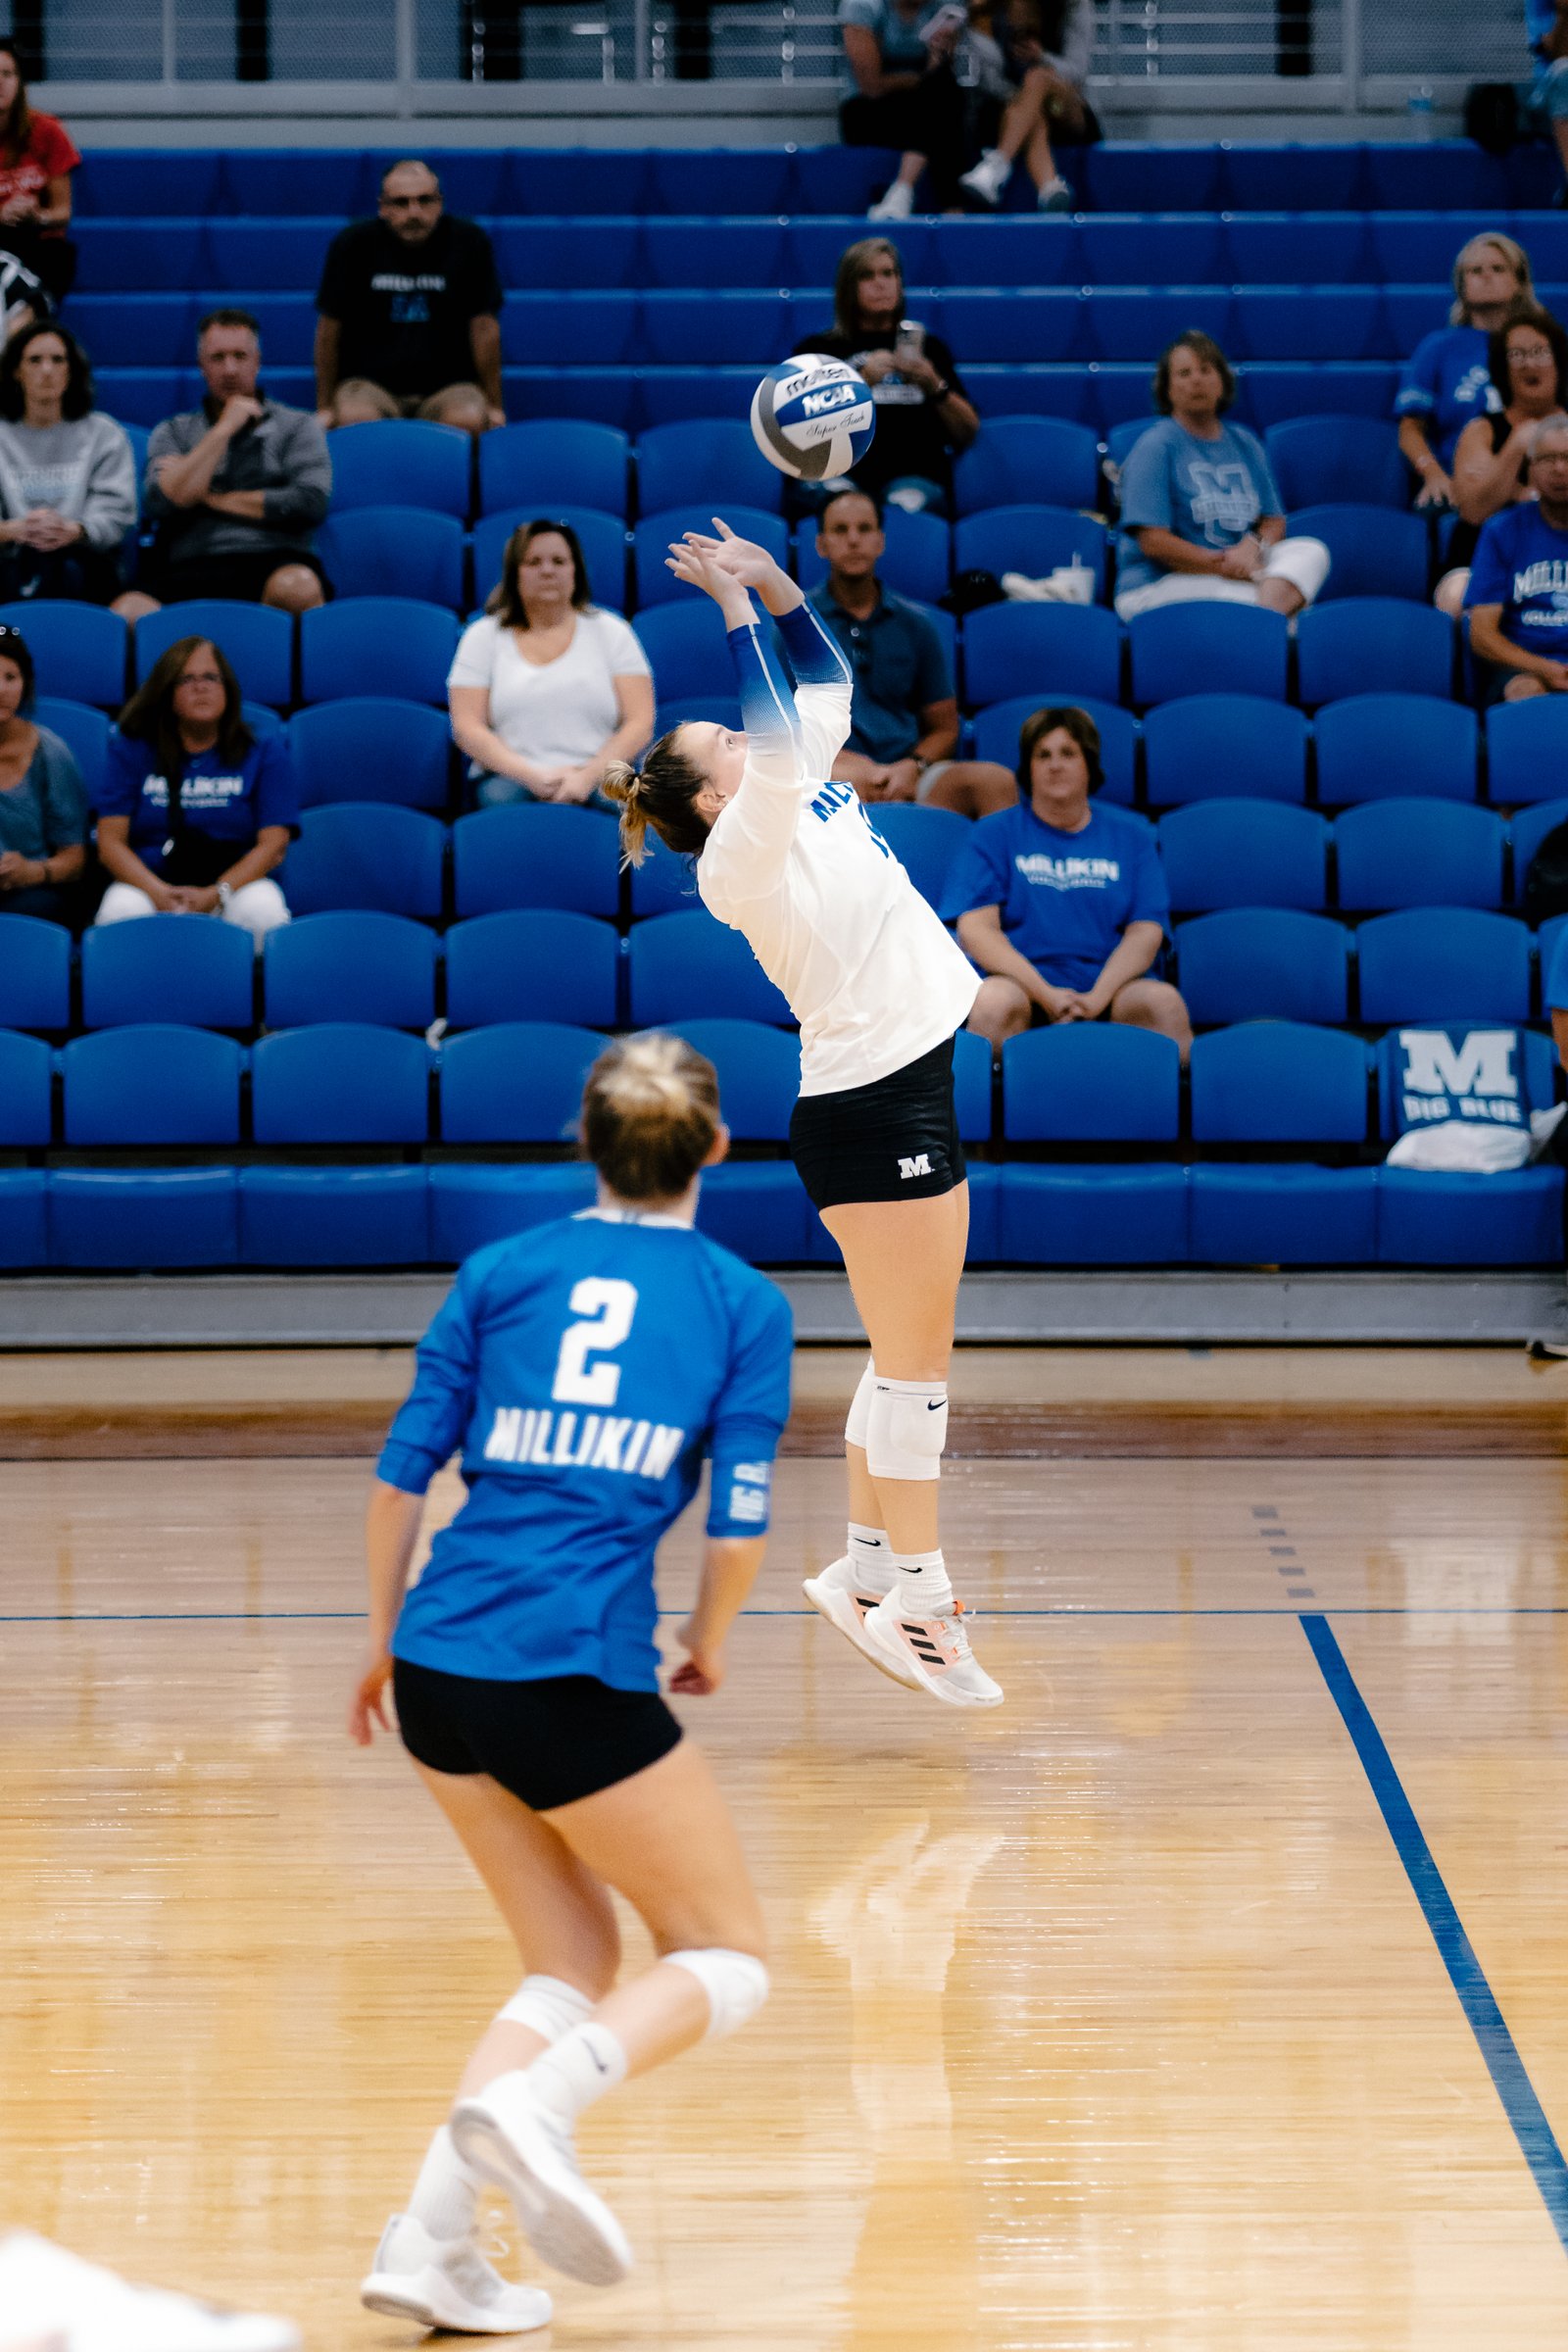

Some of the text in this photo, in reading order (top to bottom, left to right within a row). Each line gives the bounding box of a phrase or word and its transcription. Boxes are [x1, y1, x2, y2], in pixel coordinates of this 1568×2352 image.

[802, 384, 858, 418] NCAA
[1399, 1030, 1518, 1098] M
[1402, 1094, 1522, 1123] BIG BLUE
[897, 1153, 932, 1179] M
[551, 1276, 639, 1407] 2
[483, 1406, 686, 1482] MILLIKIN
